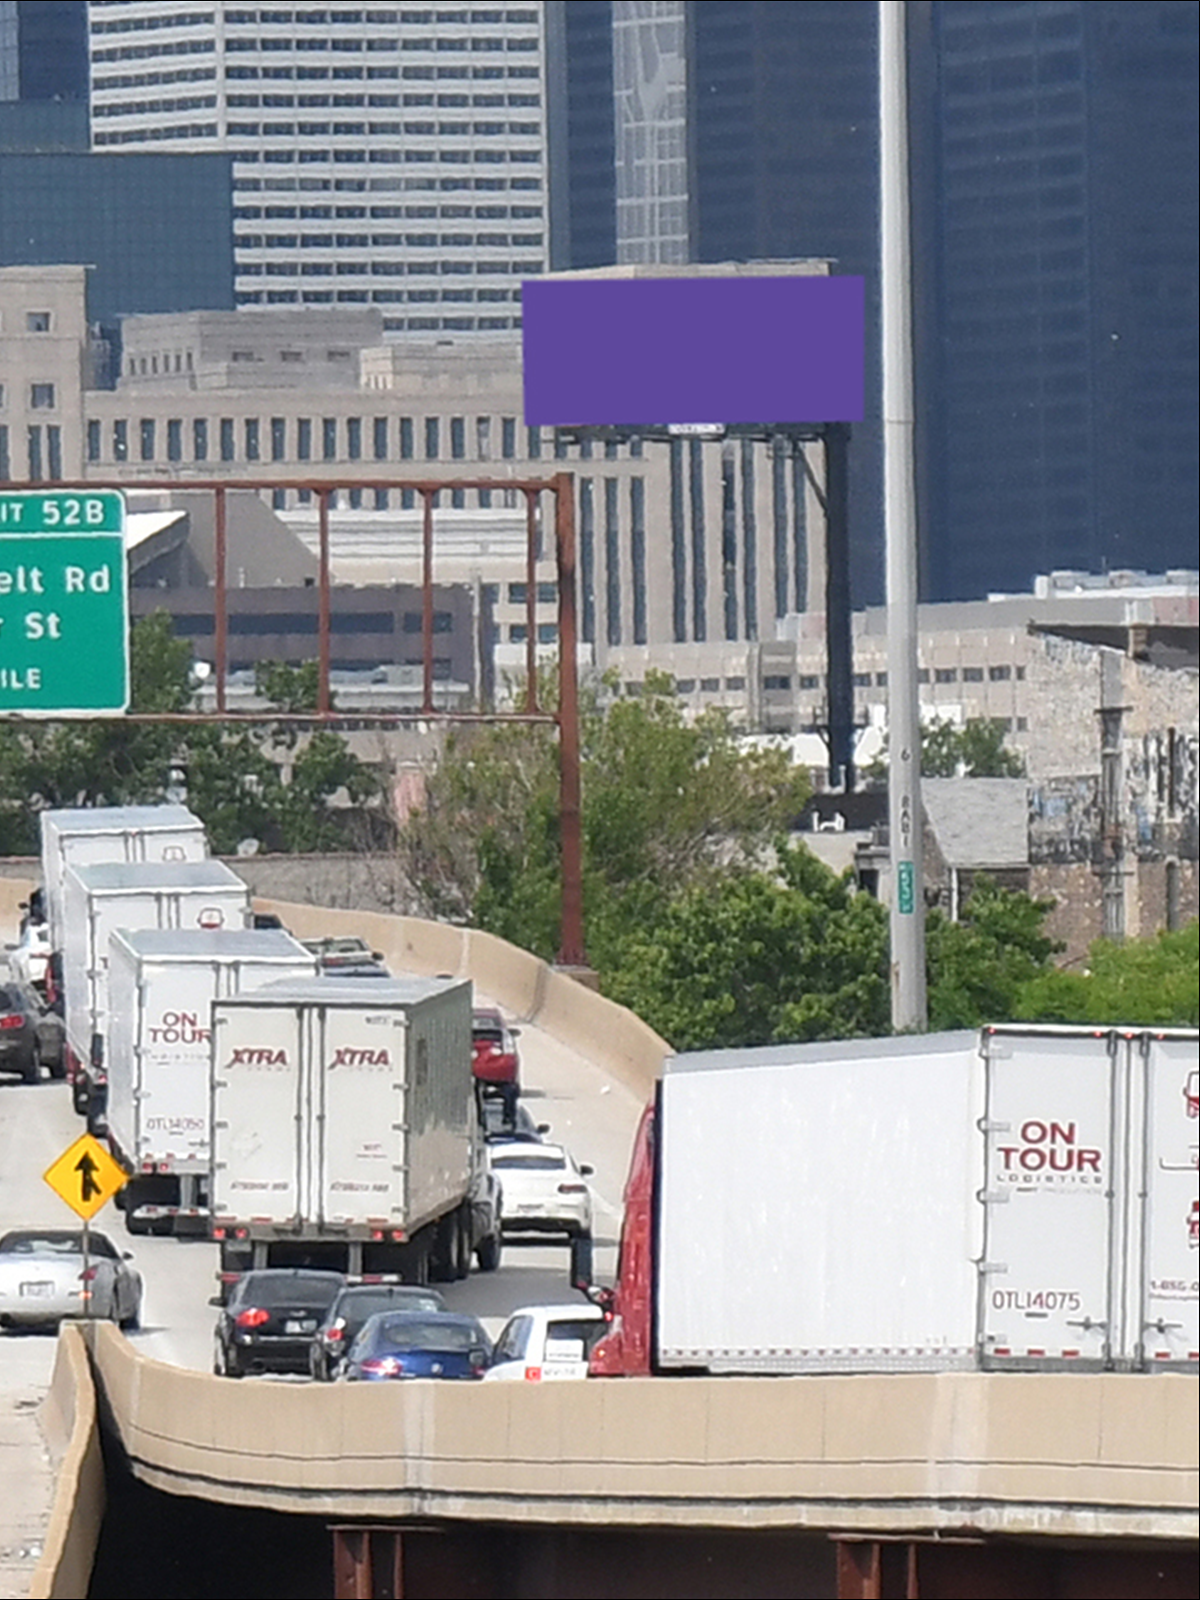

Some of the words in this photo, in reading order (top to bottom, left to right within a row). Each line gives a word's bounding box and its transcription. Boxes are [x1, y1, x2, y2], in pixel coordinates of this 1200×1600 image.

[43, 499, 103, 525] 52B
[65, 565, 109, 592] Rd
[25, 612, 60, 639] St
[162, 1011, 198, 1028] ON
[224, 1048, 289, 1069] XTRA
[327, 1048, 391, 1070] XTRA
[1020, 1120, 1077, 1146] ON
[997, 1146, 1102, 1173] TOUR
